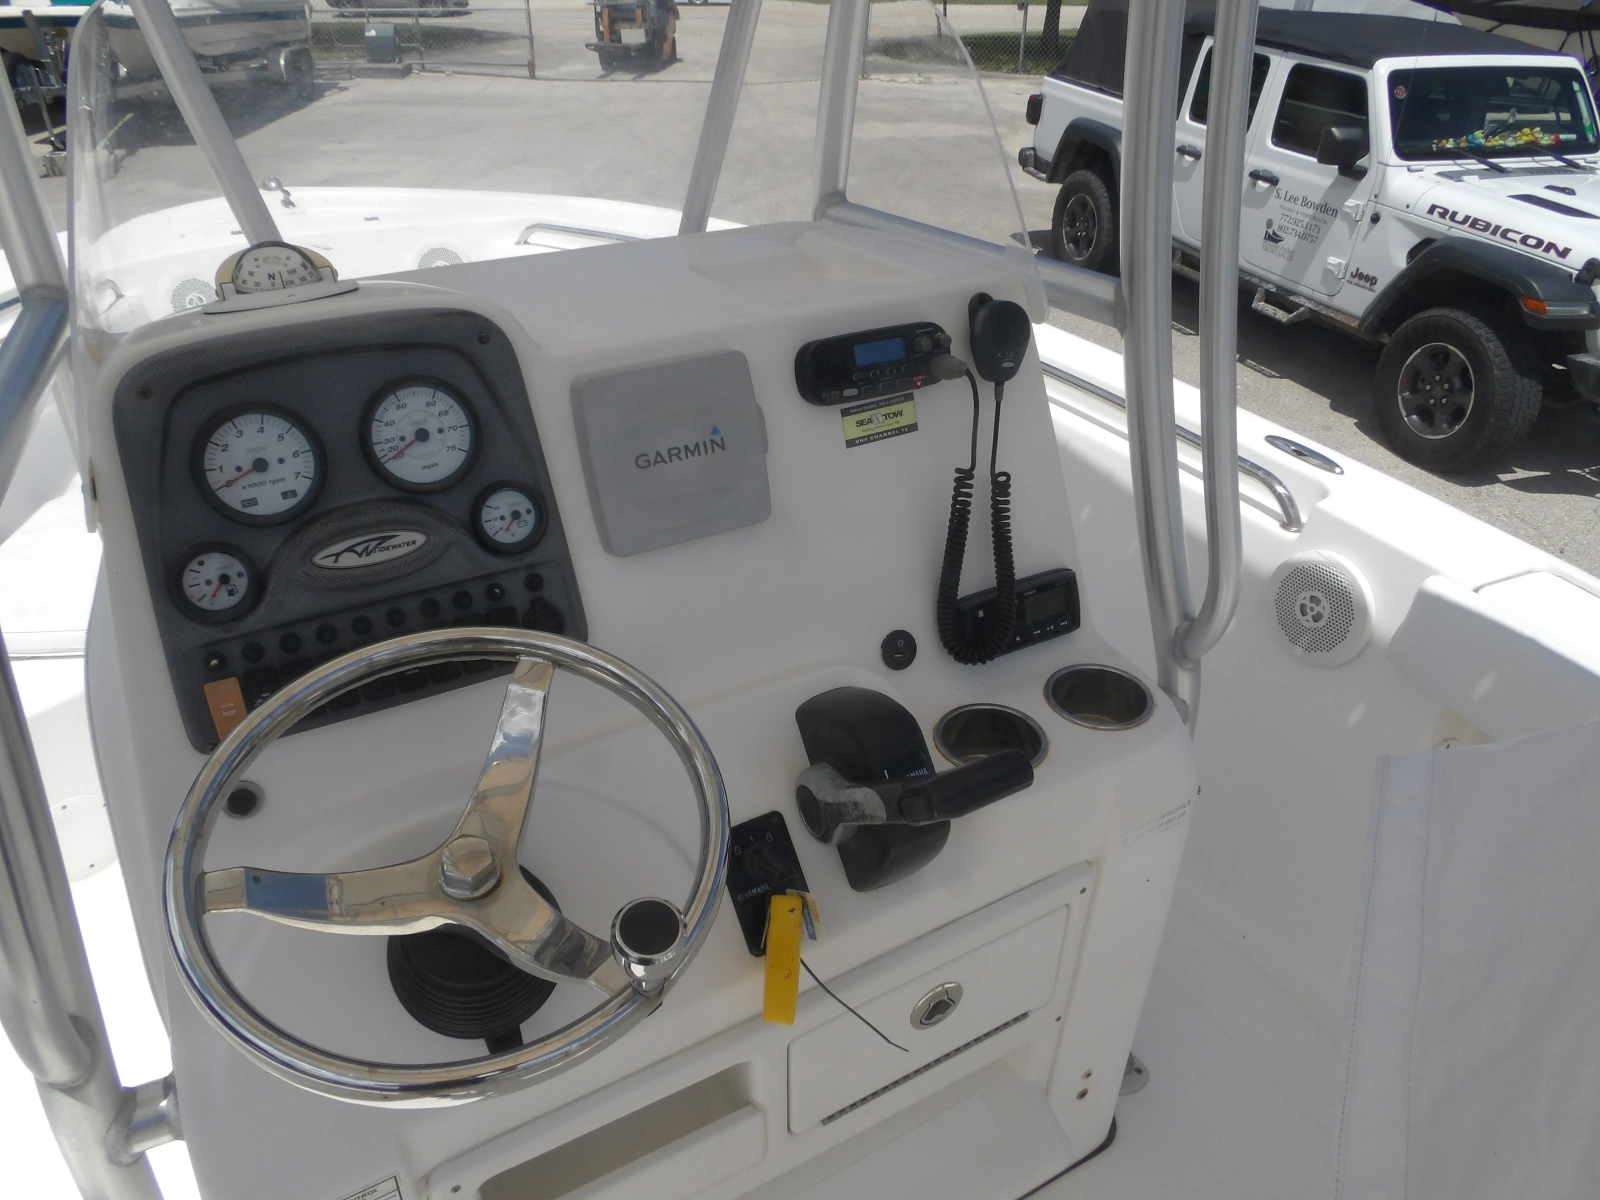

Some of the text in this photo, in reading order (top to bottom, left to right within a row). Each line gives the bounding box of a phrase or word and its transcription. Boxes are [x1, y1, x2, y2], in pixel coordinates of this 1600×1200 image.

[1274, 187, 1339, 218] S. Lee Bowden
[1426, 203, 1573, 260] RUBICON
[300, 261, 310, 271] W
[247, 270, 256, 278] NE
[267, 272, 276, 281] N
[286, 268, 297, 276] NW
[1350, 267, 1378, 287] Jeep
[395, 402, 408, 411] 50
[425, 400, 437, 408] 60
[855, 417, 874, 428] SEA
[882, 409, 903, 420] TOW
[235, 429, 243, 439] 3
[257, 426, 265, 434] 4
[277, 433, 285, 441] 5
[869, 429, 900, 441] CHANNEL
[220, 443, 229, 452] 2
[387, 445, 399, 453] 20
[292, 450, 300, 458] 6
[634, 436, 726, 470] GARMIN
[218, 465, 223, 473] 1
[421, 462, 439, 471] mph
[293, 471, 301, 480] 7
[241, 477, 286, 490] x1000 rpm
[372, 540, 417, 554] TIDEWATER
[904, 767, 929, 777] MAHA
[744, 883, 770, 898] YAMAHA
